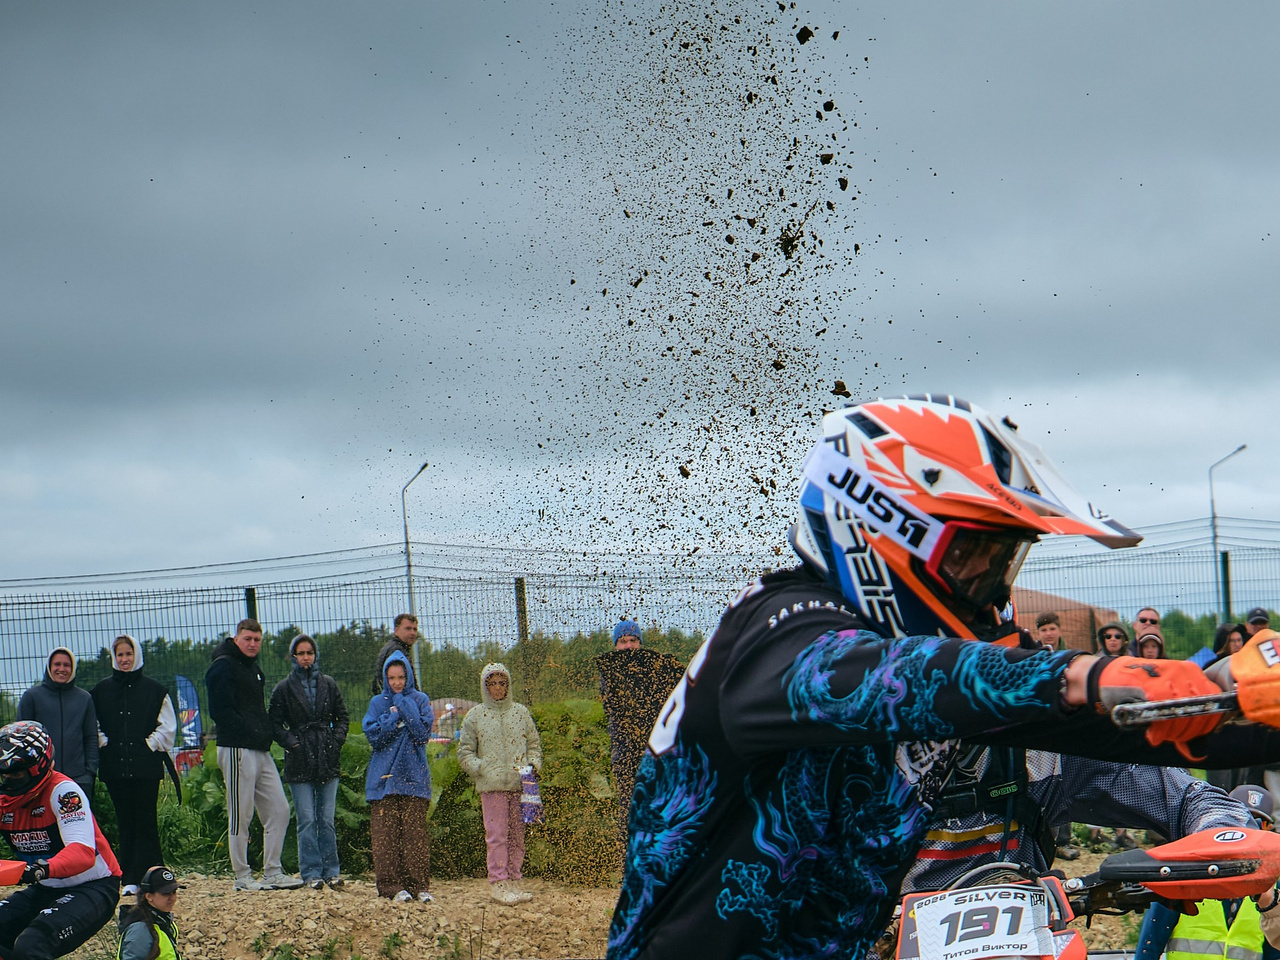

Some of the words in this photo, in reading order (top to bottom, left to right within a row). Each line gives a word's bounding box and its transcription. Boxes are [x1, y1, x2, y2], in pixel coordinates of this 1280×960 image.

[827, 467, 931, 549] JUST1
[939, 905, 1025, 947] 191
[942, 948, 979, 960] Титов
[982, 943, 1028, 952] Виктор
